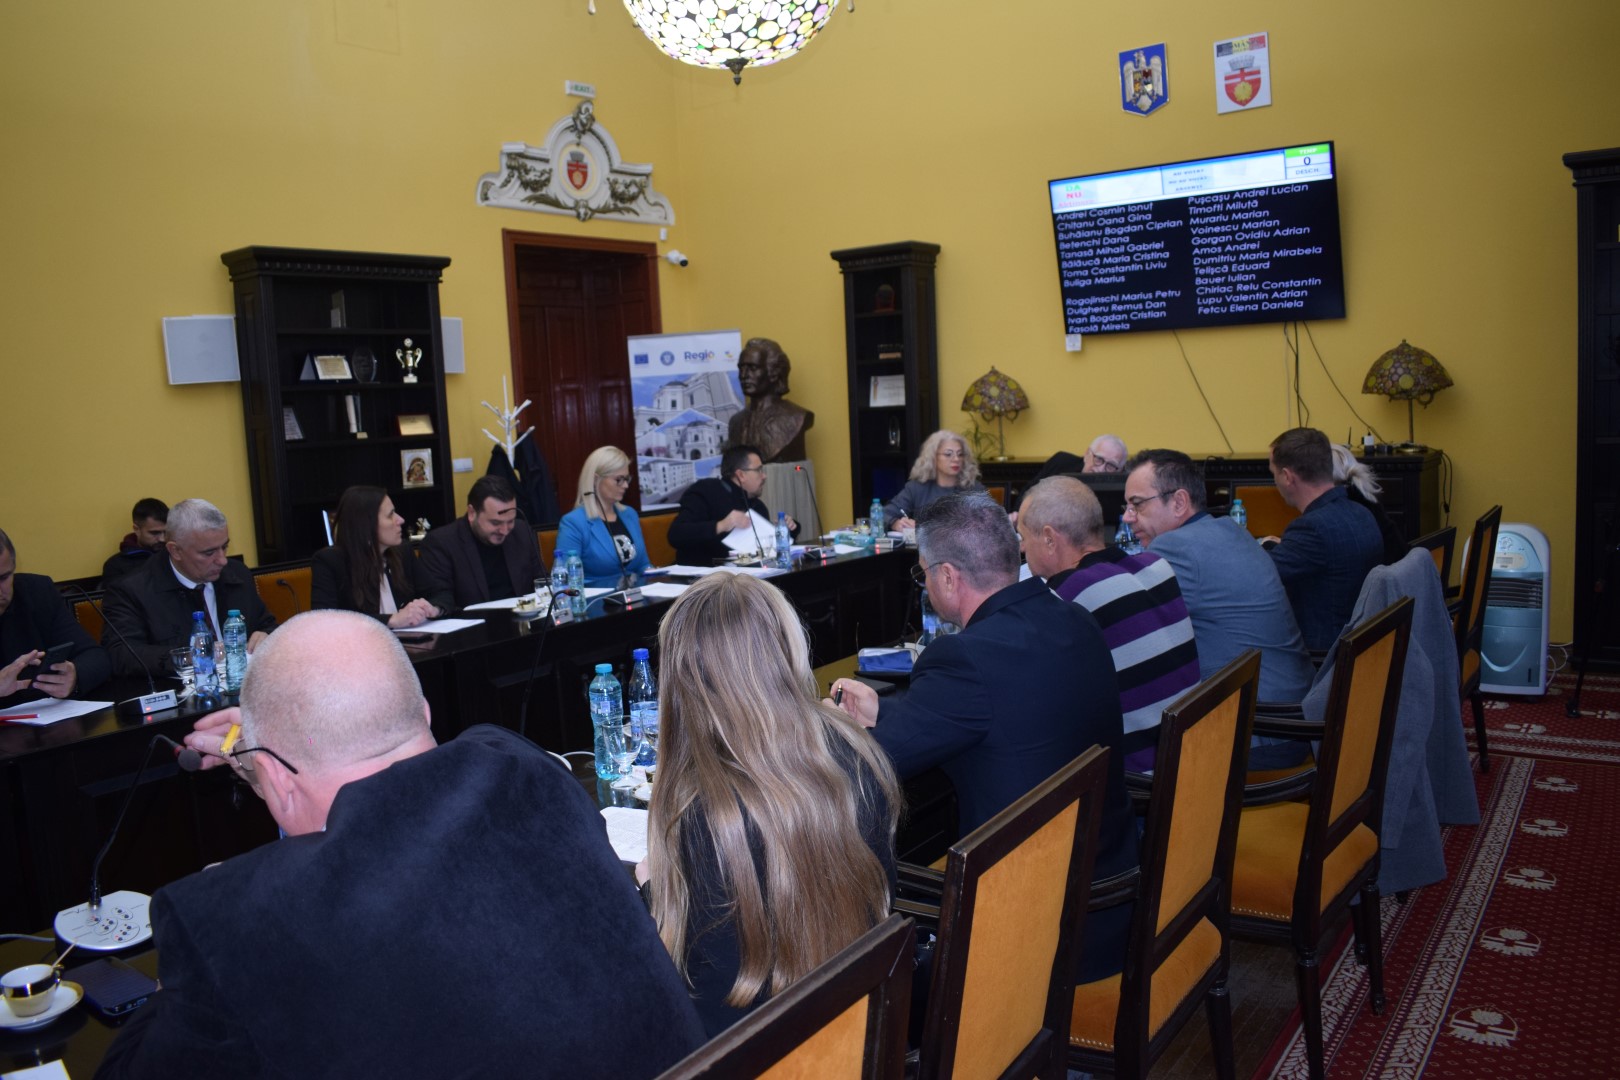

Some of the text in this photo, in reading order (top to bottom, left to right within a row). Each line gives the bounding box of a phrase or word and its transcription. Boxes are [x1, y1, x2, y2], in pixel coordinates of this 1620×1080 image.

[1233, 187, 1269, 199] Andrei
[1271, 183, 1308, 195] Lucian
[1056, 210, 1087, 221] Andrei
[1089, 206, 1126, 217] Cosmin
[1189, 204, 1223, 215] Timofti
[1190, 209, 1269, 225] Murariu Marian
[1097, 215, 1125, 226] Oana
[1127, 212, 1151, 223] Gina
[1105, 223, 1143, 236] Bogdan
[1146, 220, 1182, 230] Ciprian
[1191, 219, 1280, 235] Voinescu Marian
[1103, 235, 1129, 246] Dana
[1191, 226, 1310, 246] Gorgan Ovidiu Adrian
[1060, 241, 1164, 259] Tanasă Mihail Gabriel
[1193, 241, 1260, 255] Amos Andrei
[1103, 254, 1130, 265] Maria
[1133, 251, 1169, 261] Cristina
[1193, 246, 1322, 266] Dumitriu Maria Mirabela
[1063, 261, 1166, 278] Toma Constantin Liviu
[1232, 261, 1270, 272] Eduard
[1064, 275, 1125, 288] Buliga Marius
[1195, 273, 1256, 286] Bauer Iulian
[1196, 277, 1322, 296] Chiriac Relu Constantin
[1066, 290, 1181, 307] Rogojinschi Marius Petru
[1197, 289, 1308, 306] Lupu Valentin Adrian
[1067, 301, 1166, 316] Dulgheru Remus Dan
[1198, 299, 1304, 315] Fetcu Elena Daniela
[1068, 310, 1166, 325] Ivan Bogdan Cristian
[1068, 322, 1130, 334] Fasolă Mirela
[684, 350, 715, 361] Regio
